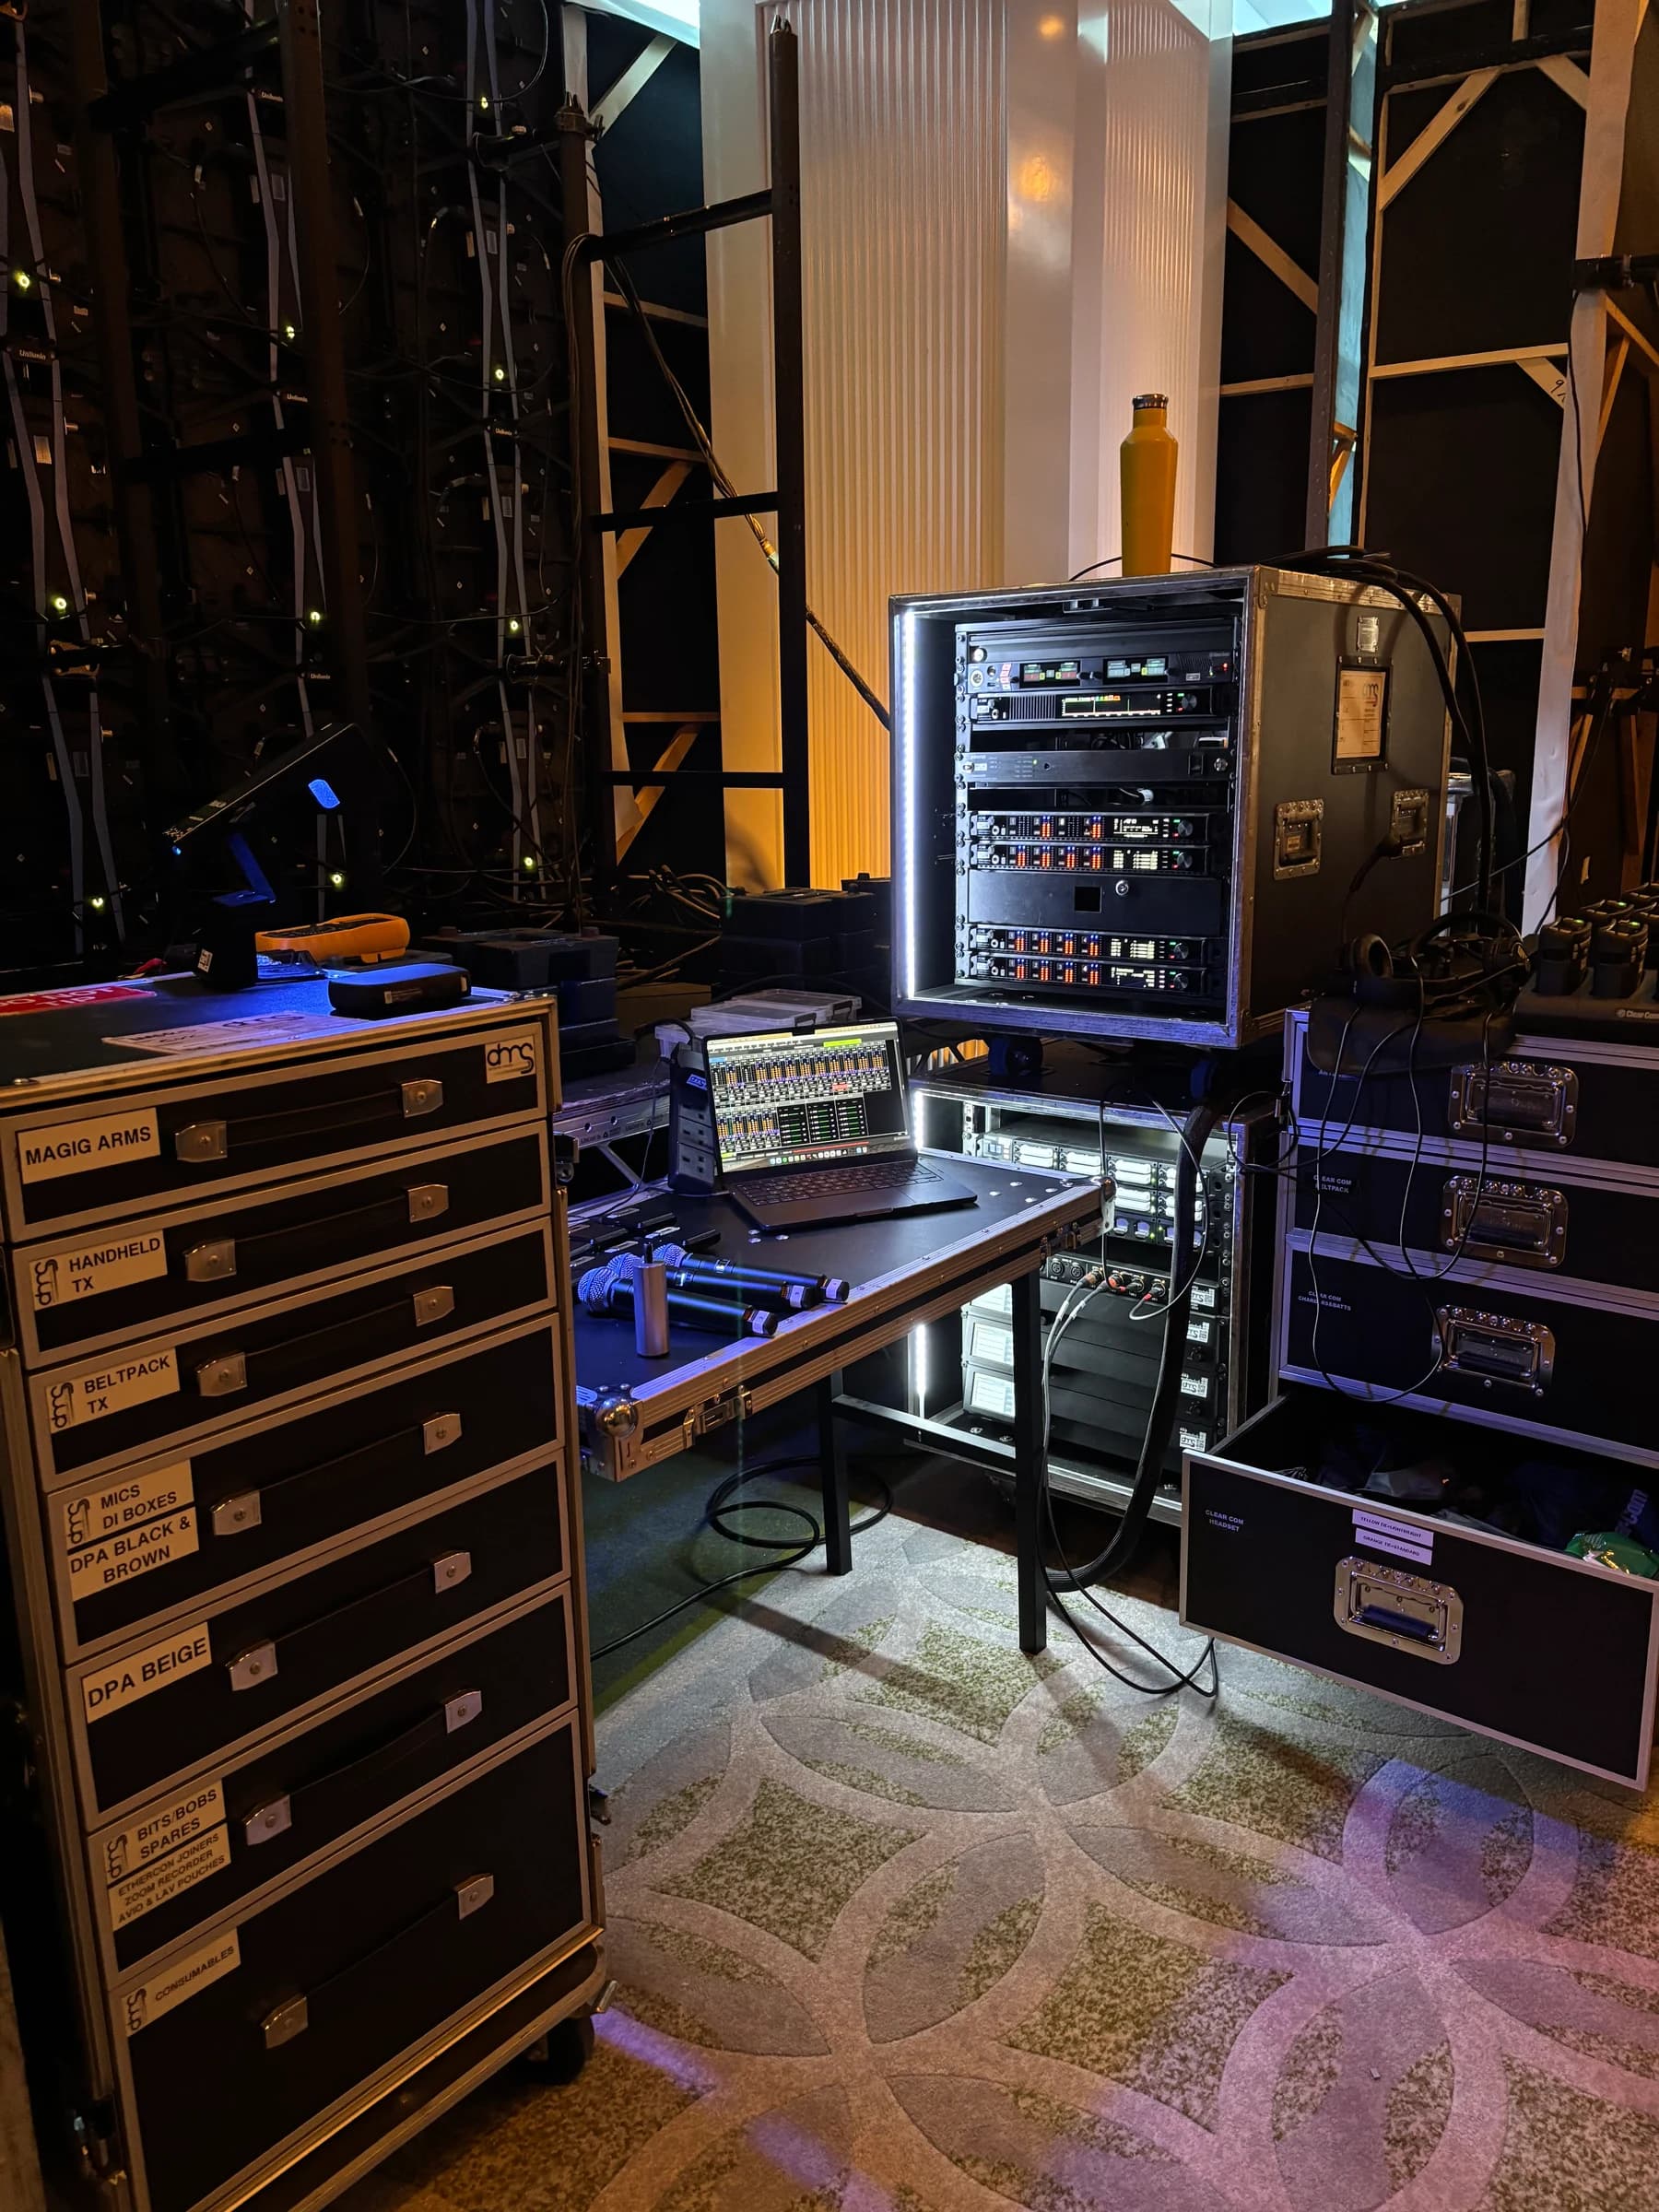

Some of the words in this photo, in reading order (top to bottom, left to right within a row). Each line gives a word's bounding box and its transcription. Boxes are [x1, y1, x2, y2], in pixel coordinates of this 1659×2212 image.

[35, 996, 97, 1006] TIP
[41, 986, 114, 1000] NOT
[487, 1042, 535, 1075] dms
[26, 1138, 92, 1166] MAGIG
[98, 1126, 151, 1151] ARMS
[69, 1237, 161, 1273] HANDHELD
[72, 1276, 94, 1293] TX
[84, 1355, 171, 1394] BELTPACK
[87, 1396, 109, 1414] TX
[100, 1484, 140, 1510] MICS
[102, 1513, 118, 1530] DI
[124, 1490, 178, 1523] BOXES
[1205, 1509, 1228, 1521] CLEAR
[1229, 1516, 1244, 1525] COM
[1209, 1518, 1240, 1532] HEADSET
[70, 1548, 109, 1574] DPA
[114, 1522, 173, 1559] BLACK
[179, 1516, 191, 1531] &
[103, 1545, 171, 1584] BROWN
[88, 1673, 135, 1708] DPA
[141, 1637, 207, 1682] BEIGE
[137, 1788, 218, 1841] BITS/BOBS
[140, 1817, 201, 1860] SPARES
[118, 1859, 175, 1897] ETHERCON
[176, 1832, 220, 1864] JOINERS
[124, 1883, 156, 1906] ZOOM
[158, 1849, 214, 1887] RECORDER
[118, 1902, 144, 1924] AVIO
[146, 1897, 154, 1908] &
[156, 1885, 176, 1902] LAV
[177, 1855, 226, 1888] POUCHES
[154, 1946, 235, 2003] CONSUMABLES
